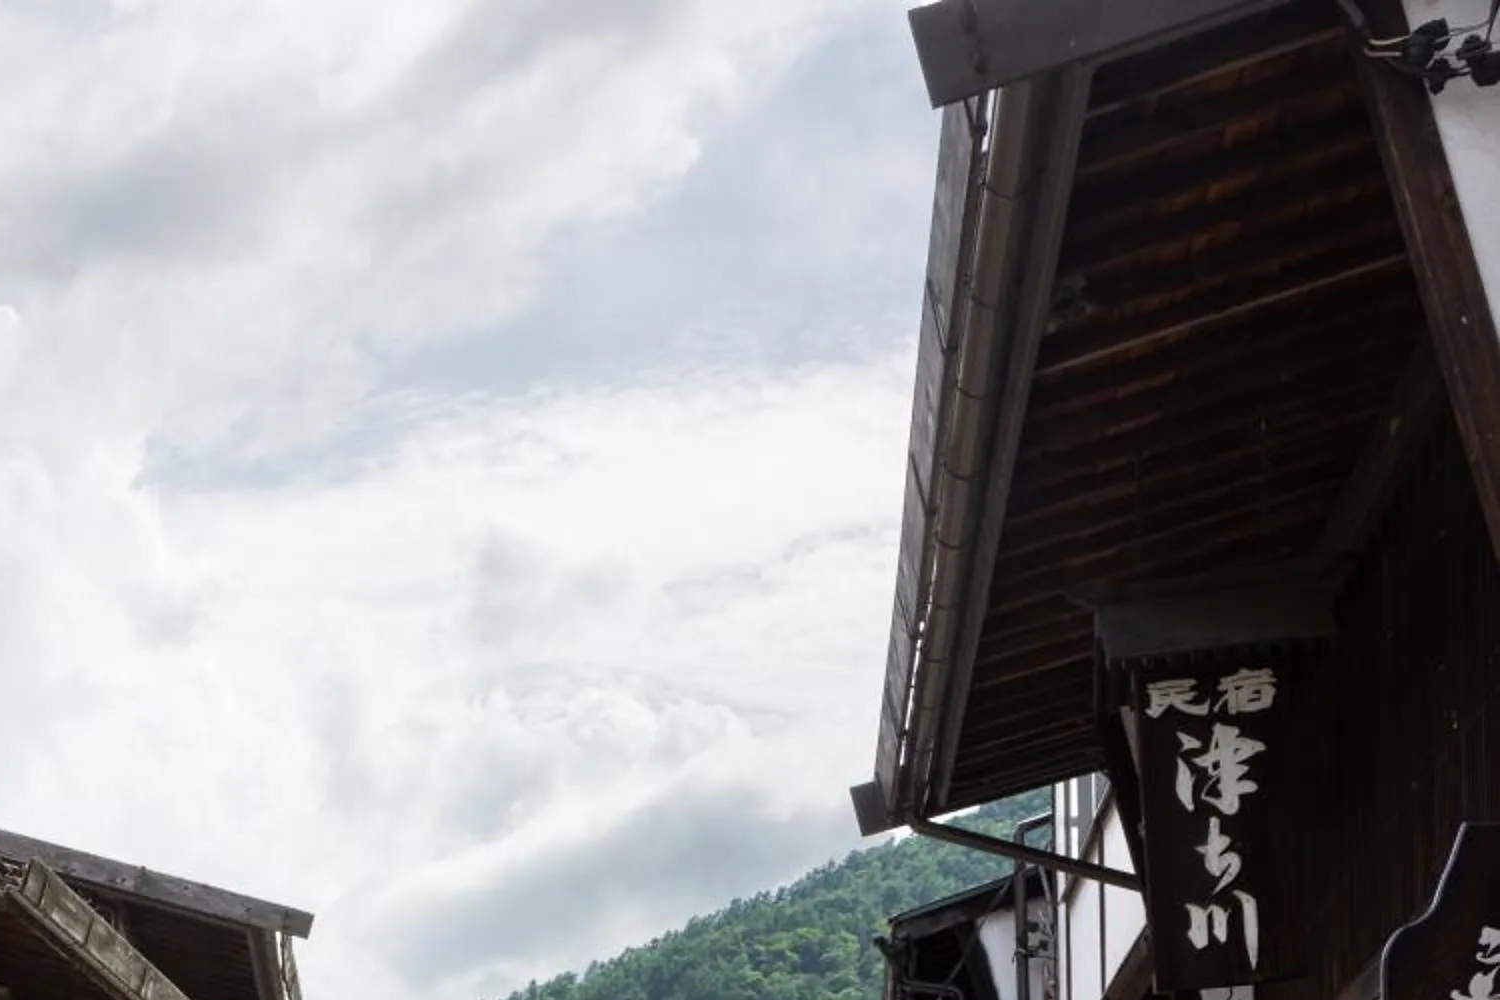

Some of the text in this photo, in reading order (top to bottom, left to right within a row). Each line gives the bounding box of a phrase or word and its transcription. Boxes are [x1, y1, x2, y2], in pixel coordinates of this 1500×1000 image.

[1143, 668, 1278, 718] 民宿
[1174, 722, 1268, 972] 津ち川
